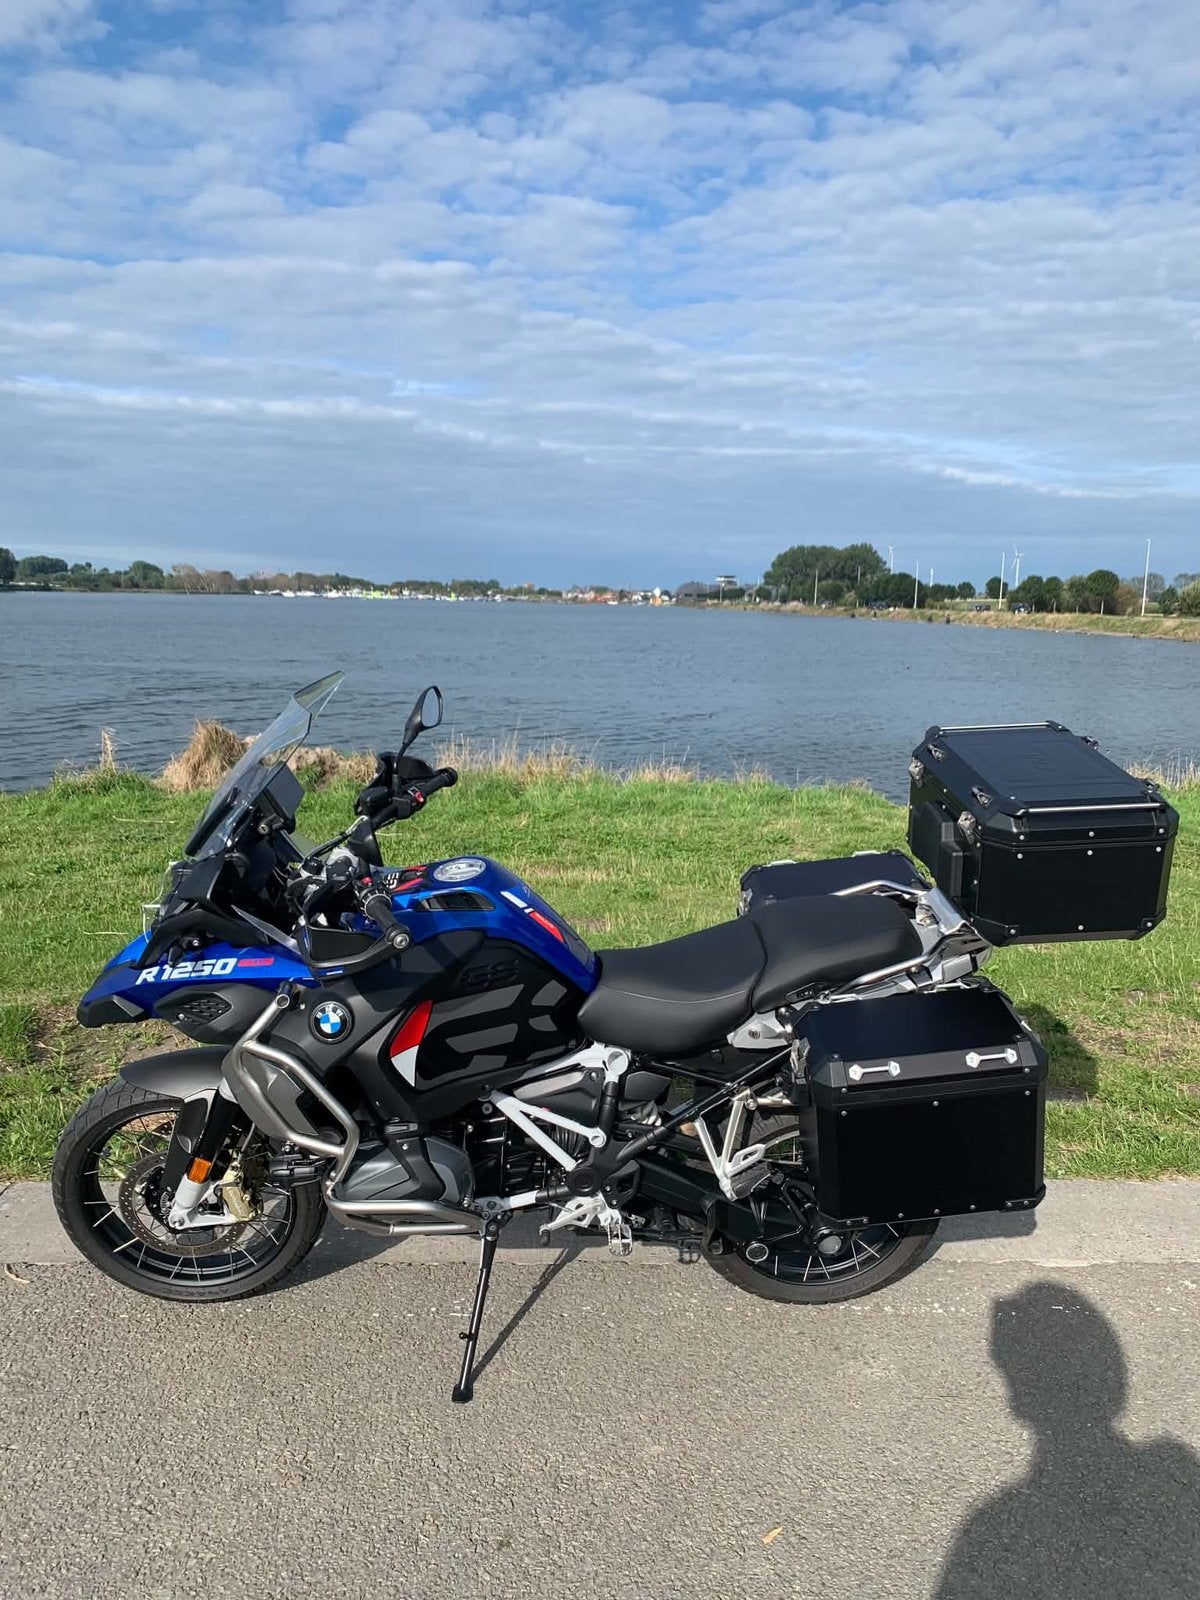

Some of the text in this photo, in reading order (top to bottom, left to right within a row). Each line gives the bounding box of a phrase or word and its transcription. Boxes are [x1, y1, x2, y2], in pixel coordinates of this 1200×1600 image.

[135, 957, 238, 985] R 1250
[316, 1004, 344, 1019] BMW
